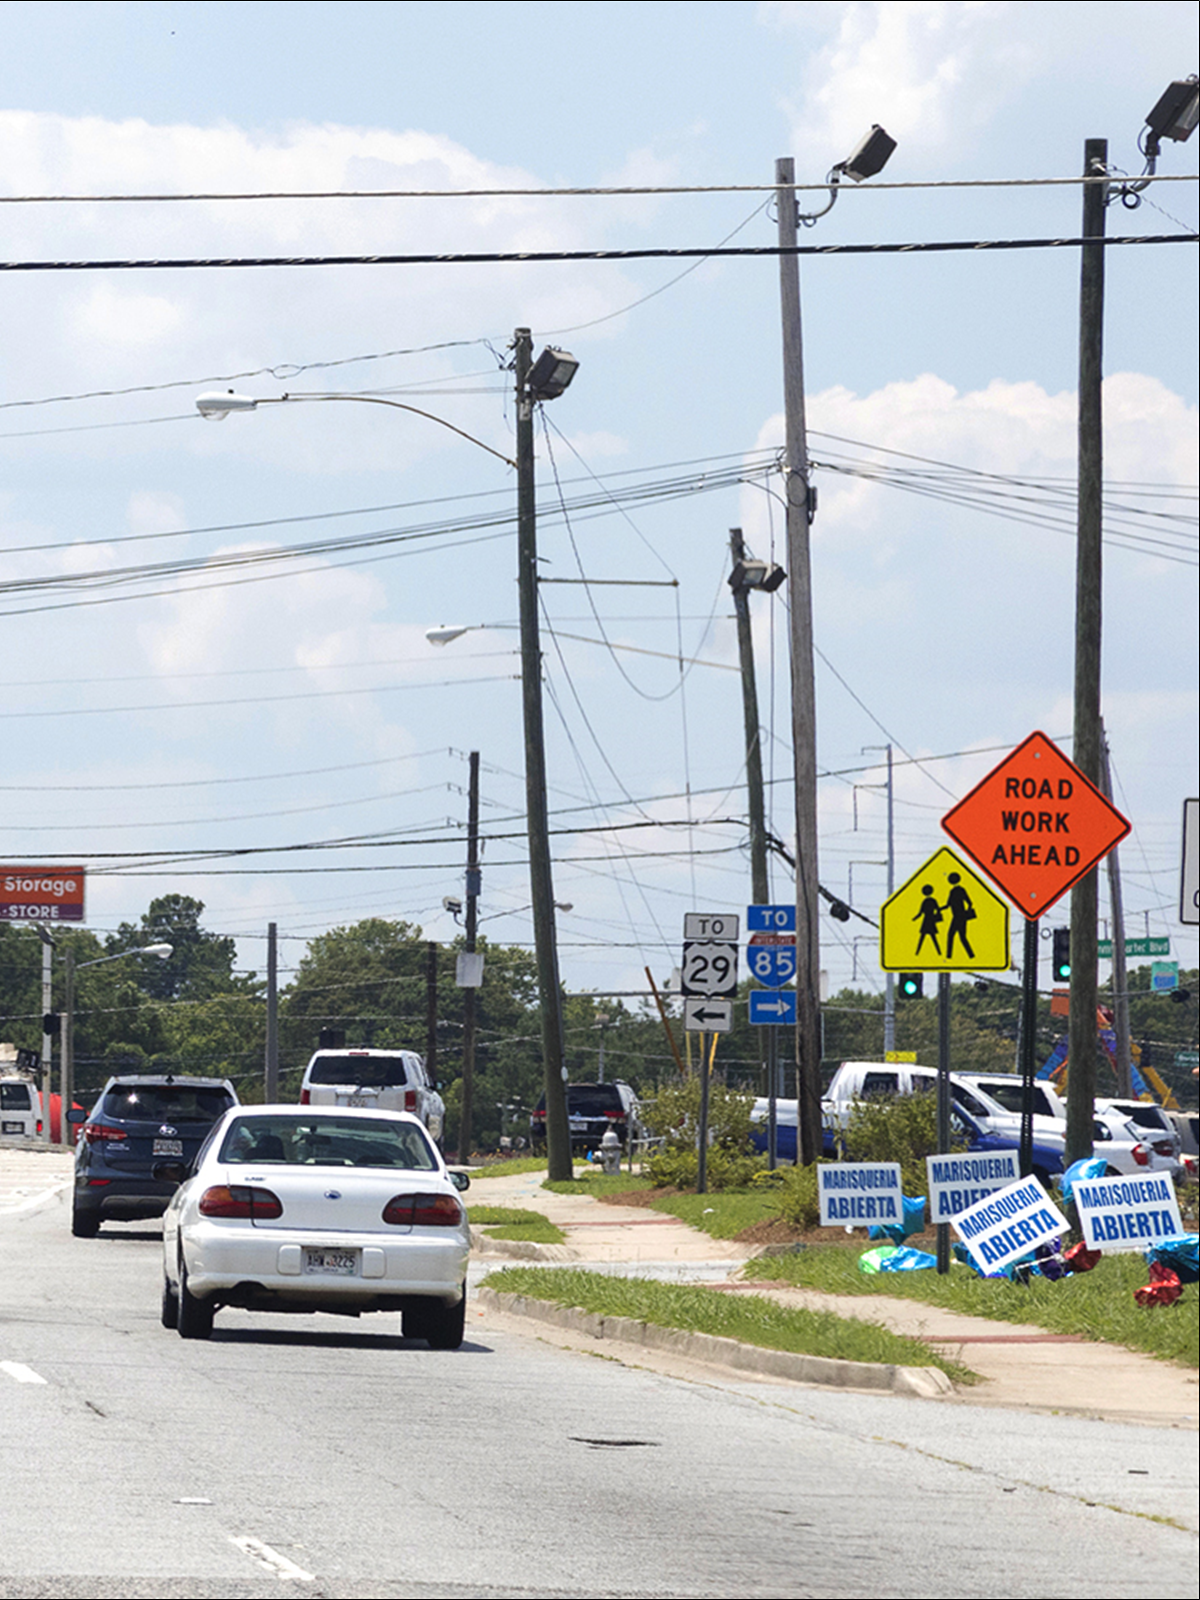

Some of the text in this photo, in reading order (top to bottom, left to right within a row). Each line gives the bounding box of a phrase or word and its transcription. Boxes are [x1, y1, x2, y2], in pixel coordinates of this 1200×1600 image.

[1006, 778, 1073, 800] ROAD
[1002, 811, 1070, 833] WORK
[991, 844, 1080, 867] AHEAD
[4, 876, 77, 897] Storage
[698, 919, 725, 935] TO
[761, 910, 788, 927] TO
[690, 955, 730, 983] 29
[755, 951, 793, 976] 85
[823, 1169, 899, 1192] MARISQUERIA
[932, 1157, 1016, 1183] MARISQUERIA
[1079, 1180, 1172, 1208] MARISQUERIA
[828, 1196, 897, 1219] ABIERTA
[958, 1183, 1044, 1240] MARISQUERIA
[979, 1208, 1060, 1265] ABIERTA
[1091, 1210, 1176, 1241] ABIERTA
